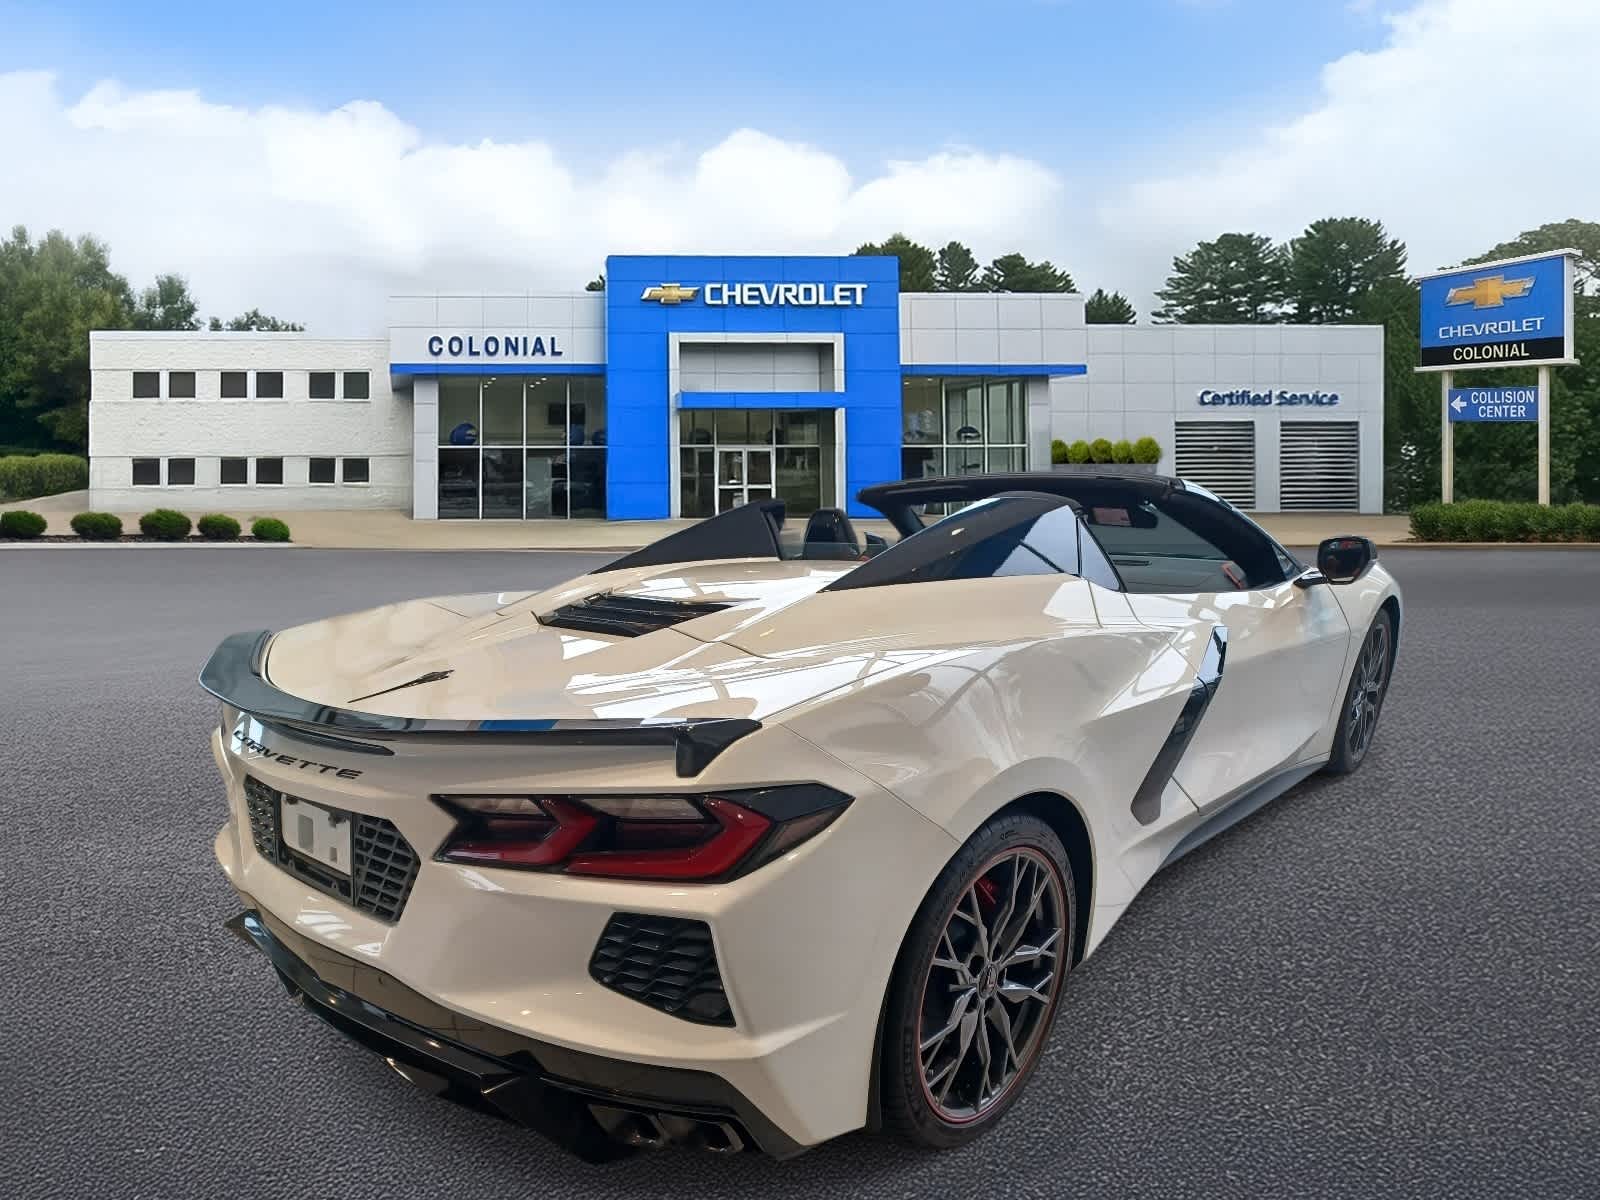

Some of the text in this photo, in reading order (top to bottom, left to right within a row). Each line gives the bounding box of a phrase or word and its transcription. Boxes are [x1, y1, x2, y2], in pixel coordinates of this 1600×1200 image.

[704, 283, 867, 306] CHEVROLET
[1438, 317, 1544, 339] CHEVROLET
[428, 336, 564, 357] COLONIAL
[1453, 343, 1530, 360] COLONIAL
[1199, 389, 1339, 407] Certified Service
[1471, 390, 1535, 404] COLLISION
[1478, 405, 1526, 418] CENTER
